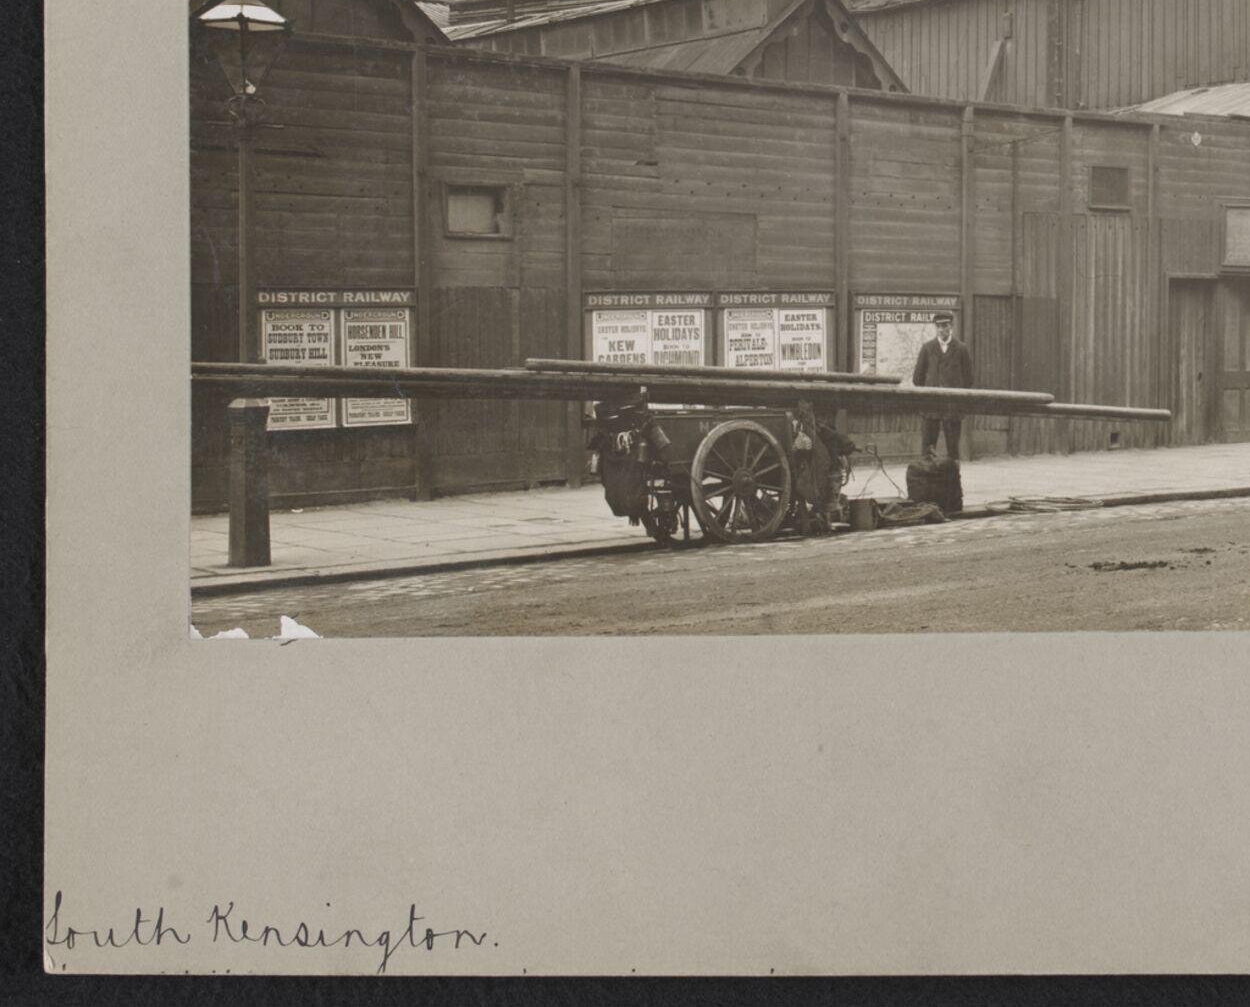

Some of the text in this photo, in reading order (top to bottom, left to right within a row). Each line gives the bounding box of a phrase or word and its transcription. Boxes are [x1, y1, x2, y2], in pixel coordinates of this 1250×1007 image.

[258, 292, 411, 303] DISTRICT RAILWAY
[588, 295, 710, 305] DISTRICT RAILWAY
[720, 294, 831, 304] DISTRICT RAILWAY
[857, 296, 958, 306] DISTRICT RAILWAY
[658, 315, 695, 326] EASTER
[784, 314, 817, 322] EASTER
[865, 312, 906, 322] DISTRICT
[653, 328, 700, 341] HOLIDAYS
[608, 340, 635, 352] KEW
[781, 343, 821, 361] WIMBLEDON
[46, 890, 191, 949] South
